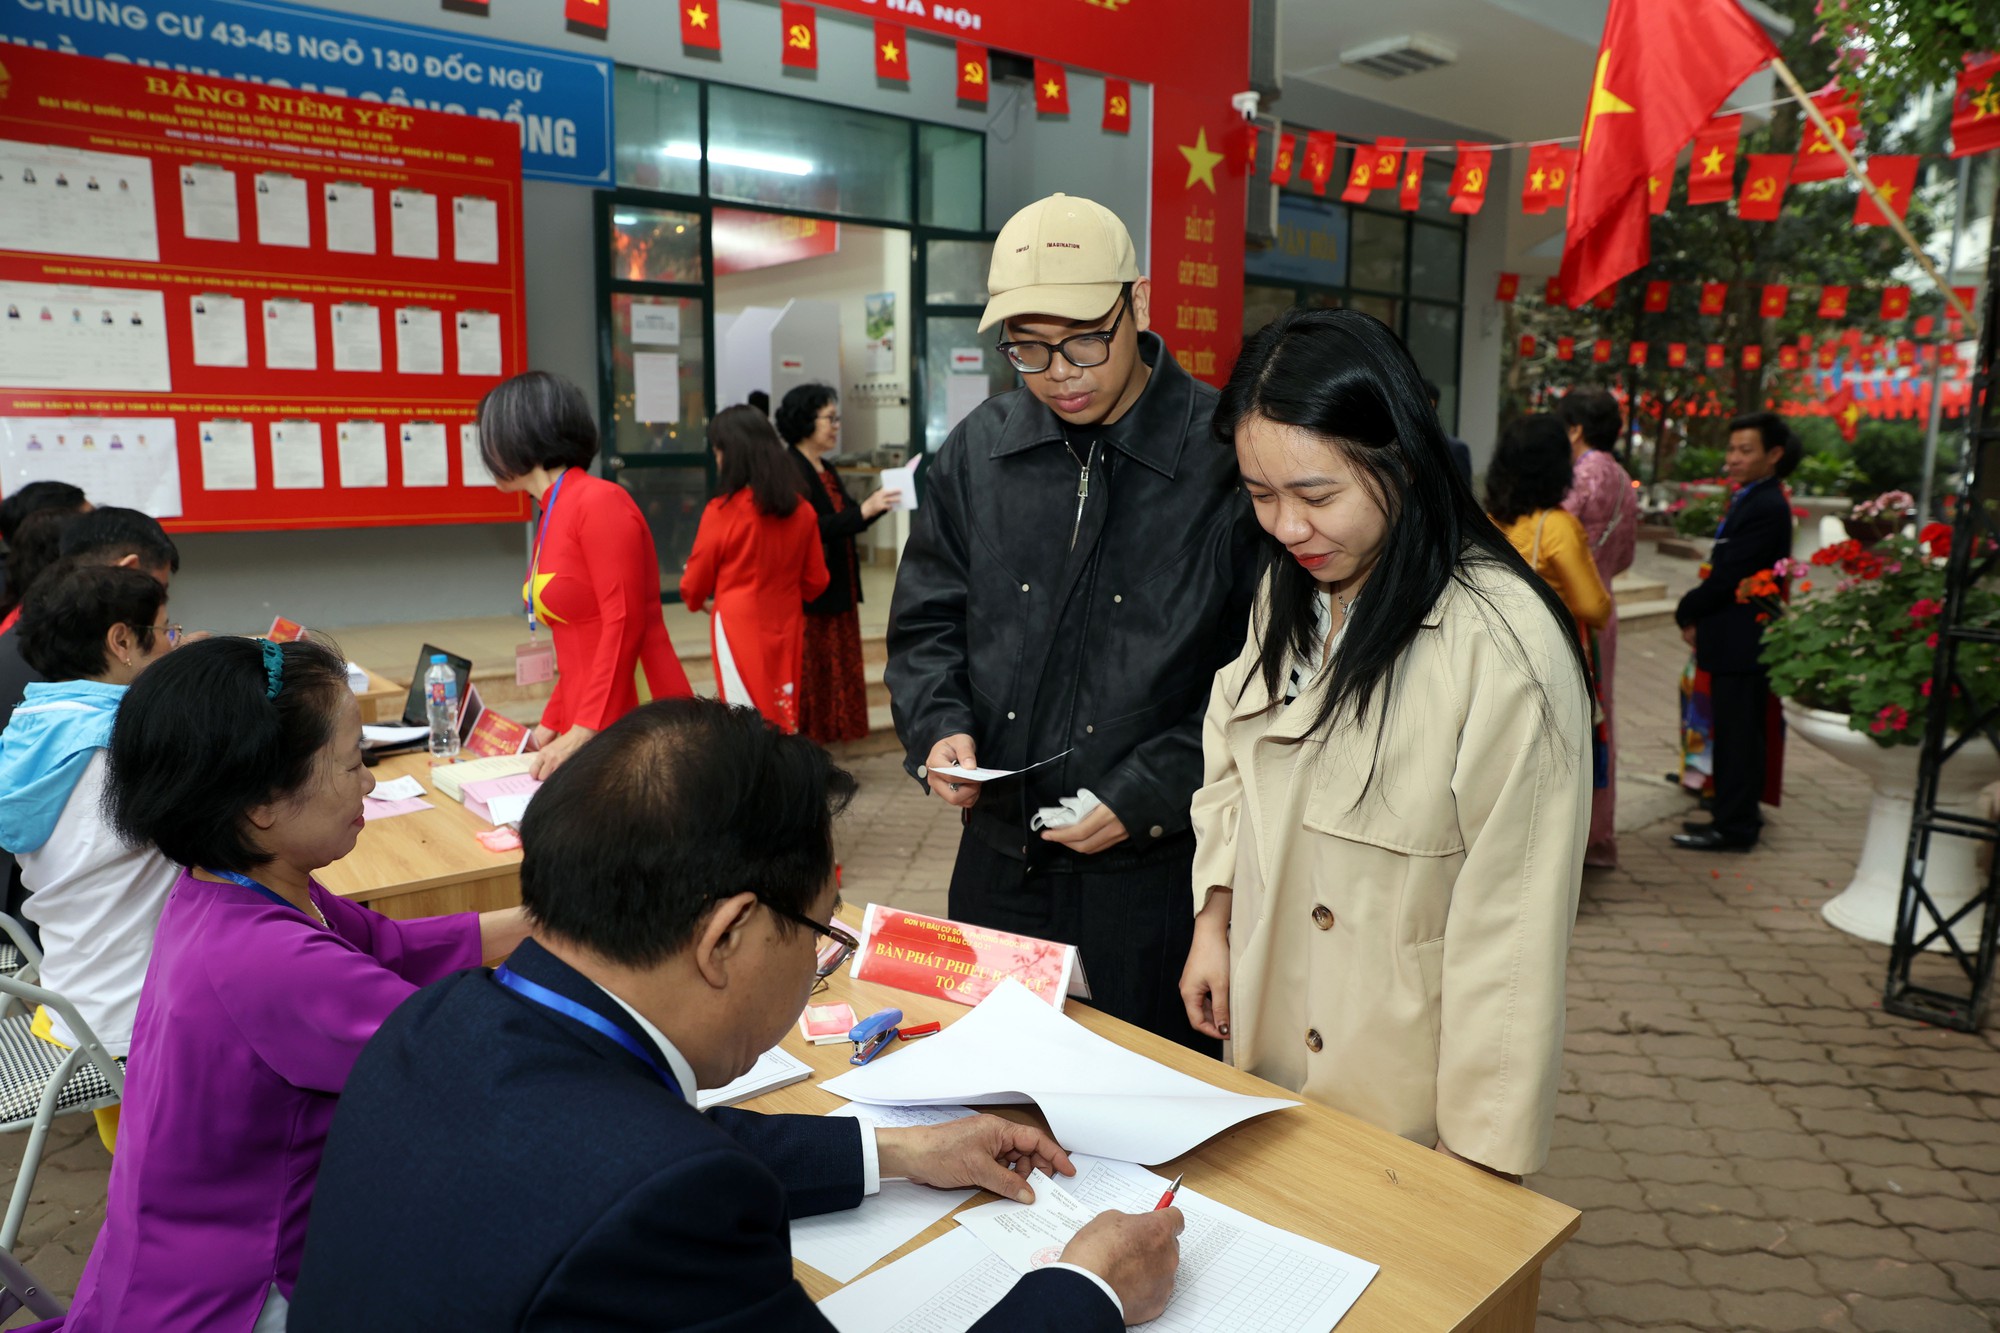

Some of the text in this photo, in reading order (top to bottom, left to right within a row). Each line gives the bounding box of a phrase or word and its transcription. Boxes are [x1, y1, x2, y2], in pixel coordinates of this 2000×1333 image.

[934, 4, 981, 30] NỘI
[156, 12, 204, 40] CƯ
[210, 22, 292, 55] 43-45
[298, 35, 364, 66] NGÕ
[371, 48, 418, 75] 130
[424, 53, 483, 84] ĐỐC
[489, 66, 543, 92] NGỮ
[145, 75, 247, 107] BẢNG
[257, 93, 345, 121] NIÊM
[354, 106, 415, 131] YẾT
[1046, 242, 1080, 250] IMAGINATION
[903, 917, 919, 927] ĐƠN
[919, 921, 926, 930] VỊ
[926, 922, 940, 932] BẦU
[941, 925, 952, 934] CỬ
[947, 935, 961, 945] BẦU
[875, 942, 903, 960] BÀN
[905, 950, 944, 969] PHÁT
[945, 959, 990, 979] PHIẾU
[957, 981, 973, 995] 45
